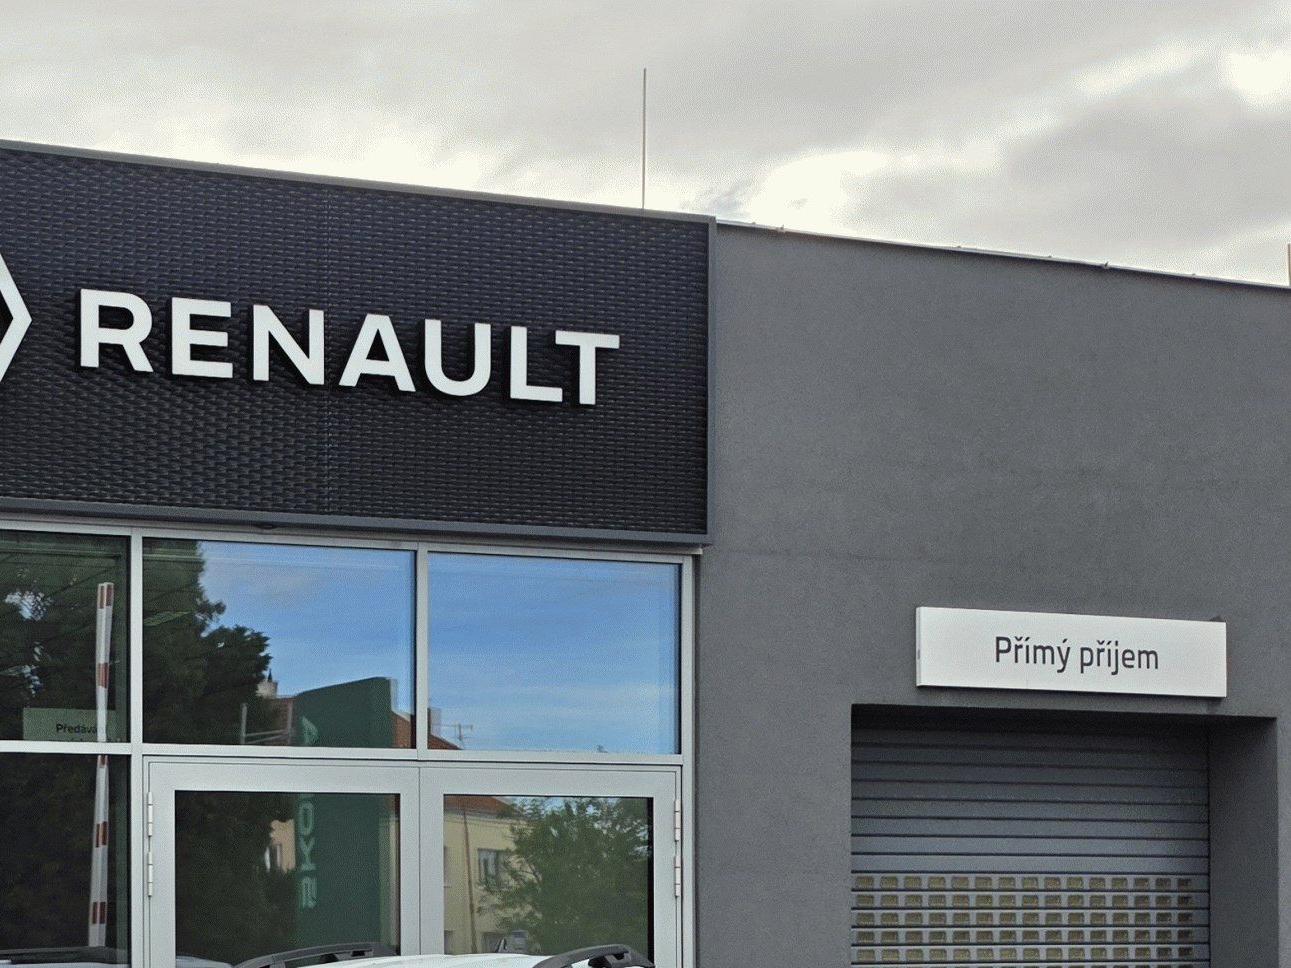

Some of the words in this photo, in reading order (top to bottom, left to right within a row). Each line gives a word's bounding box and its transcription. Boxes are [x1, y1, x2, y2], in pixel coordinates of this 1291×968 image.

[80, 288, 621, 405] RENAULT
[995, 635, 1071, 673] Přímý
[1079, 640, 1159, 675] příjem
